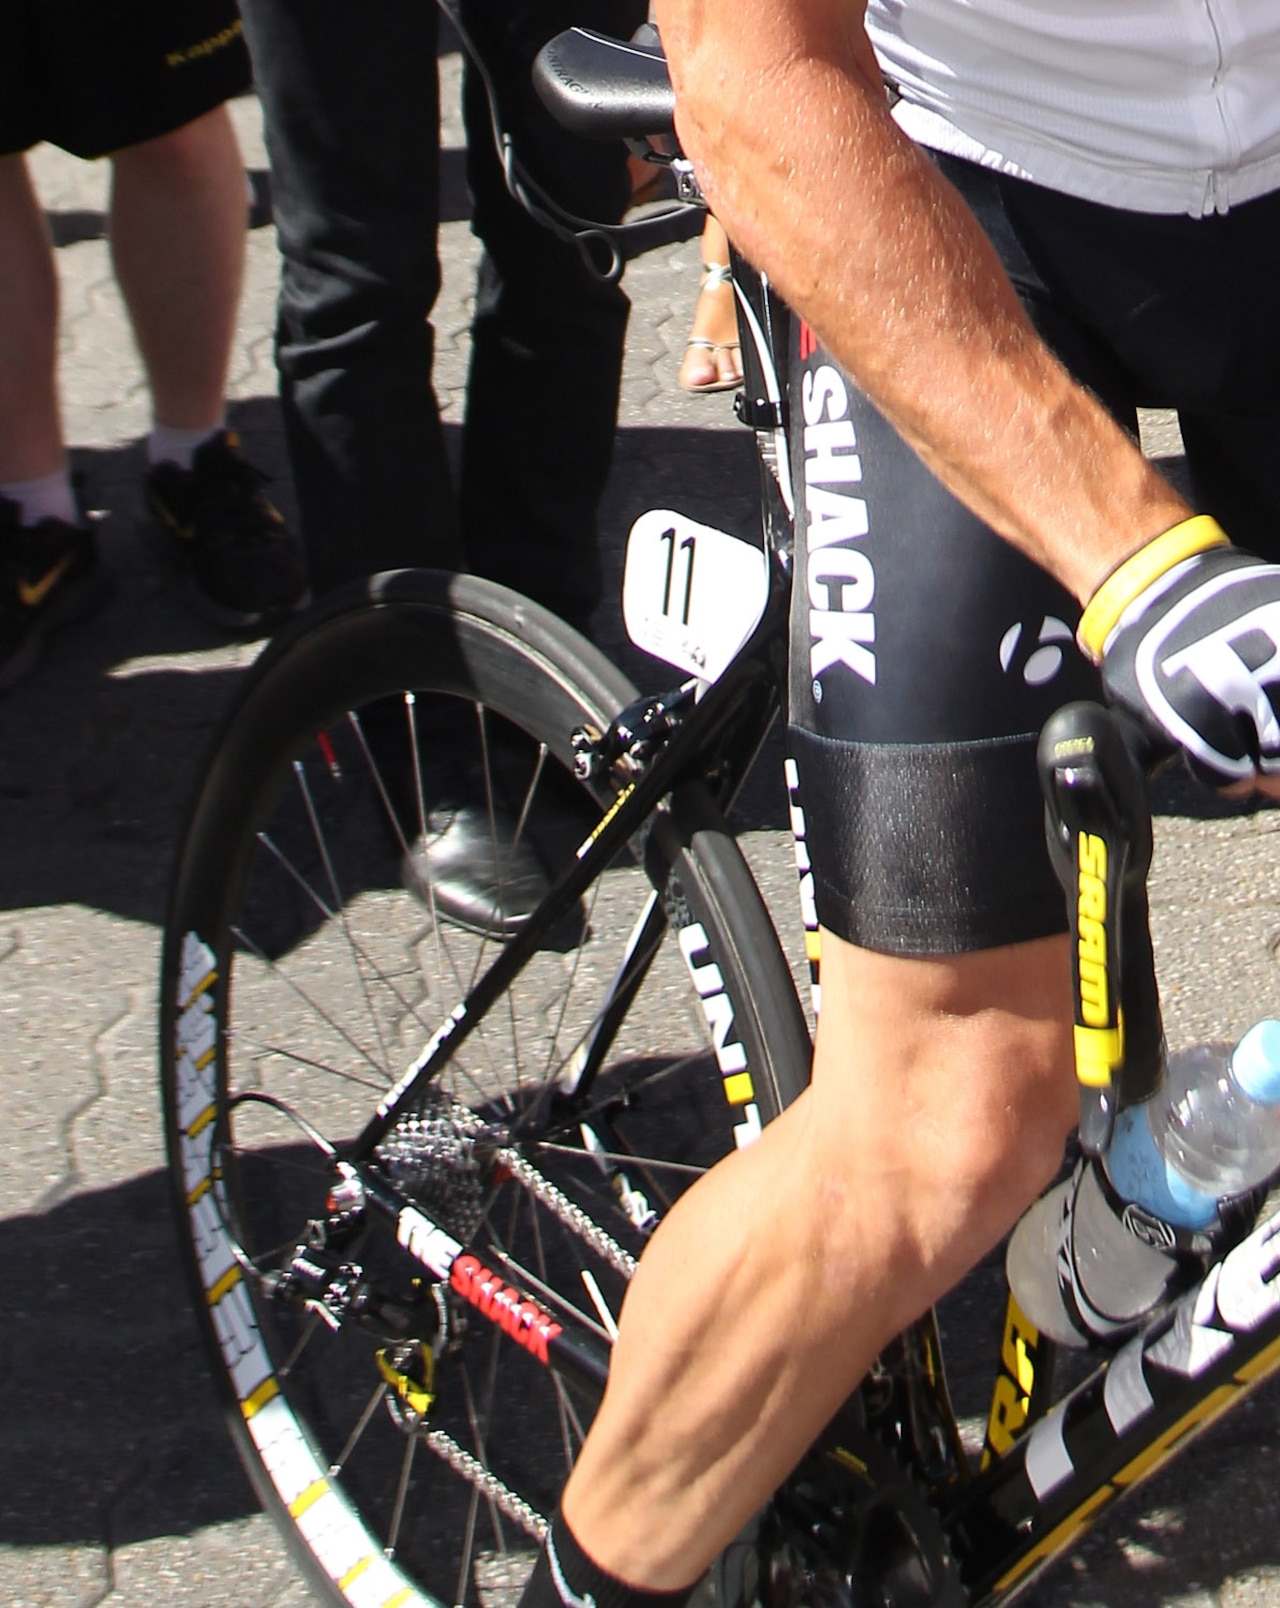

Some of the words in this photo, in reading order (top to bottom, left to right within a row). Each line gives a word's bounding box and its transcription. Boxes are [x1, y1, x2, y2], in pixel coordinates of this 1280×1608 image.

[660, 527, 696, 626] 11
[802, 365, 877, 685] SHACK
[1078, 831, 1108, 1027] SRAM
[450, 1254, 564, 1366] SHACK
